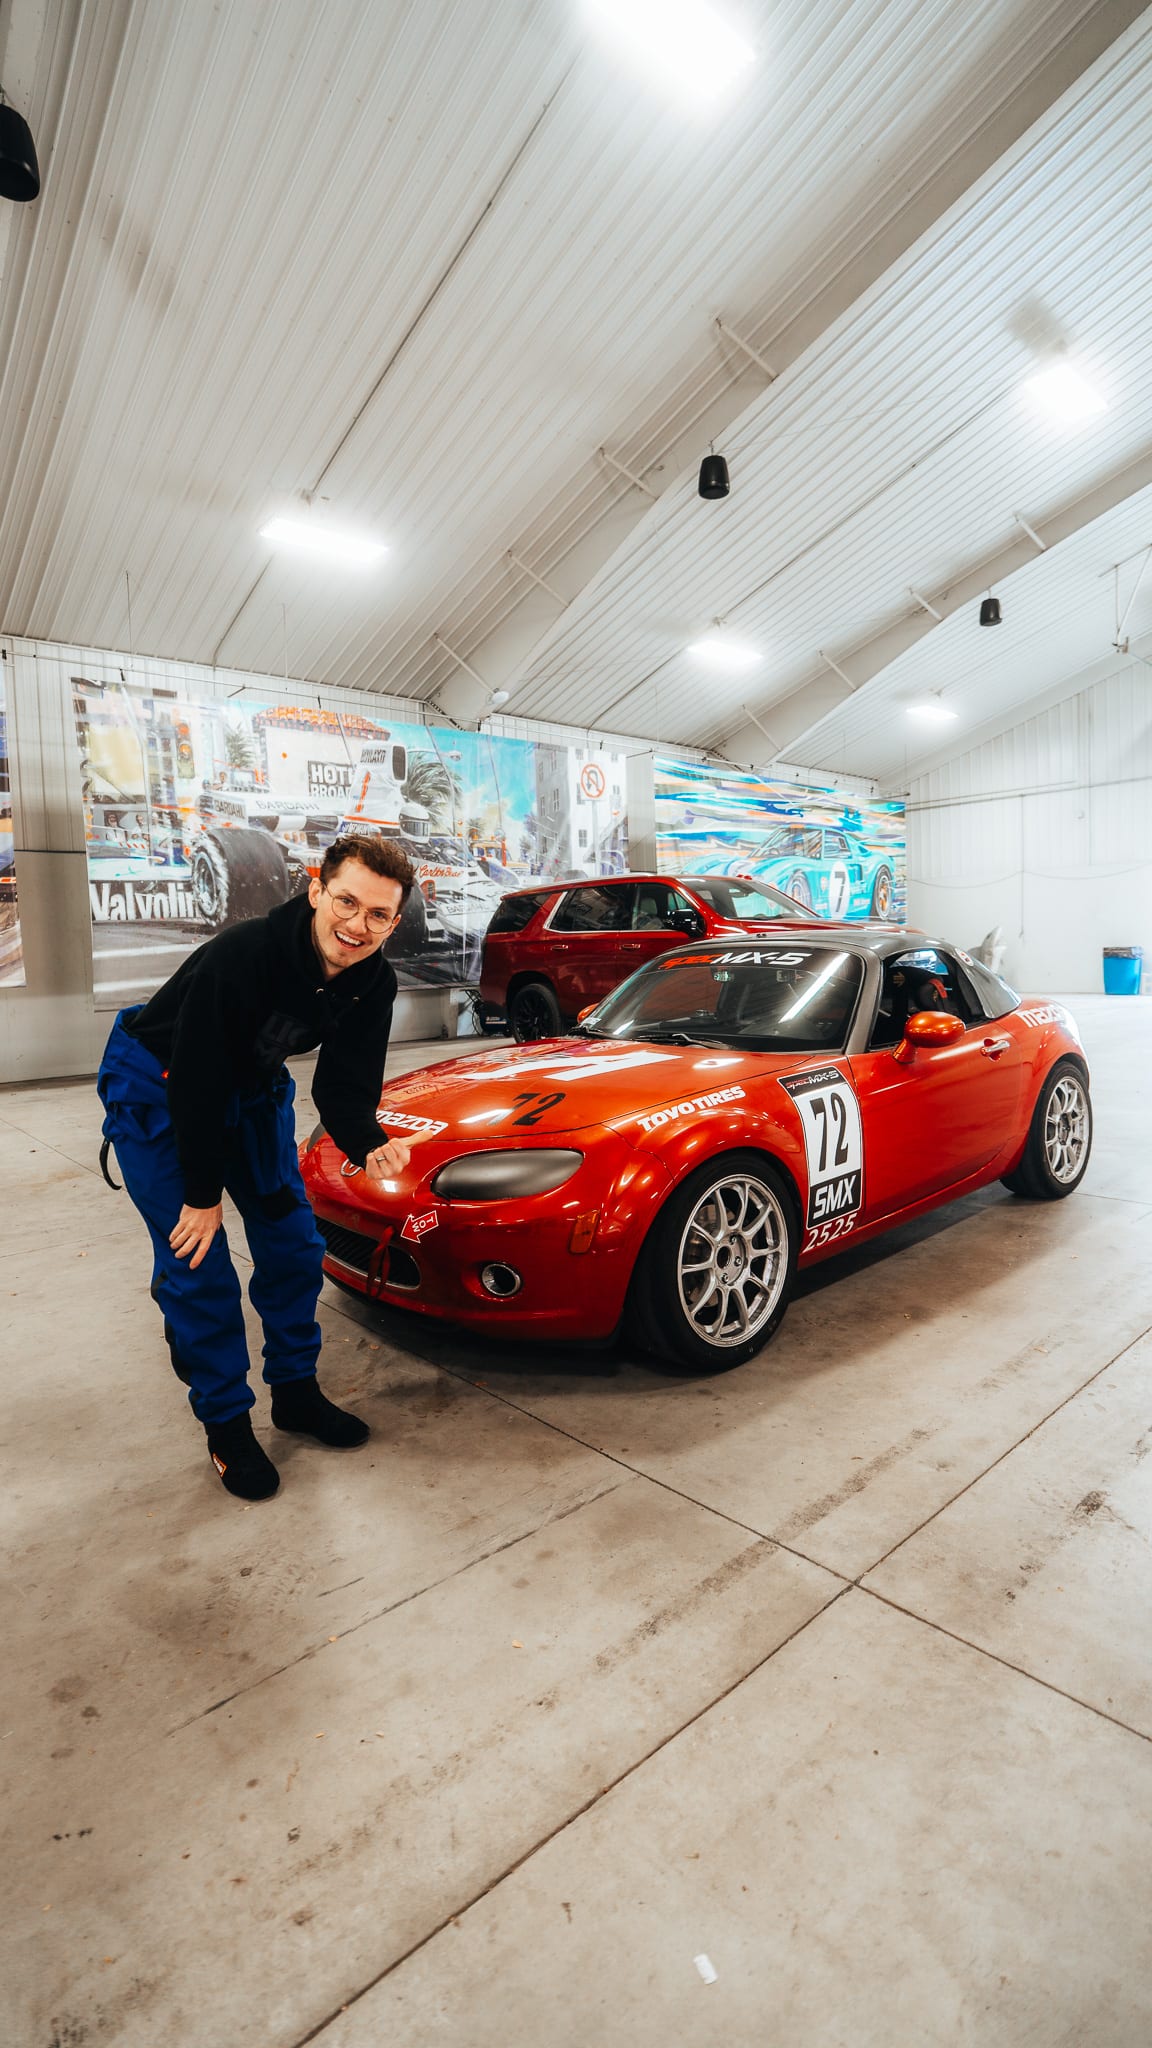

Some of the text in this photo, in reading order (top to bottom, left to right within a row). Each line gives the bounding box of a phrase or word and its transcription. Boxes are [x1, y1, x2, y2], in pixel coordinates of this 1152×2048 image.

[834, 871, 846, 913] 7
[490, 1092, 566, 1126] 72
[637, 1085, 746, 1132] TOYO TIRES
[809, 1091, 849, 1172] 72
[813, 1174, 856, 1219] SMX
[412, 1216, 434, 1233] TOW
[802, 1212, 858, 1253] 2525
